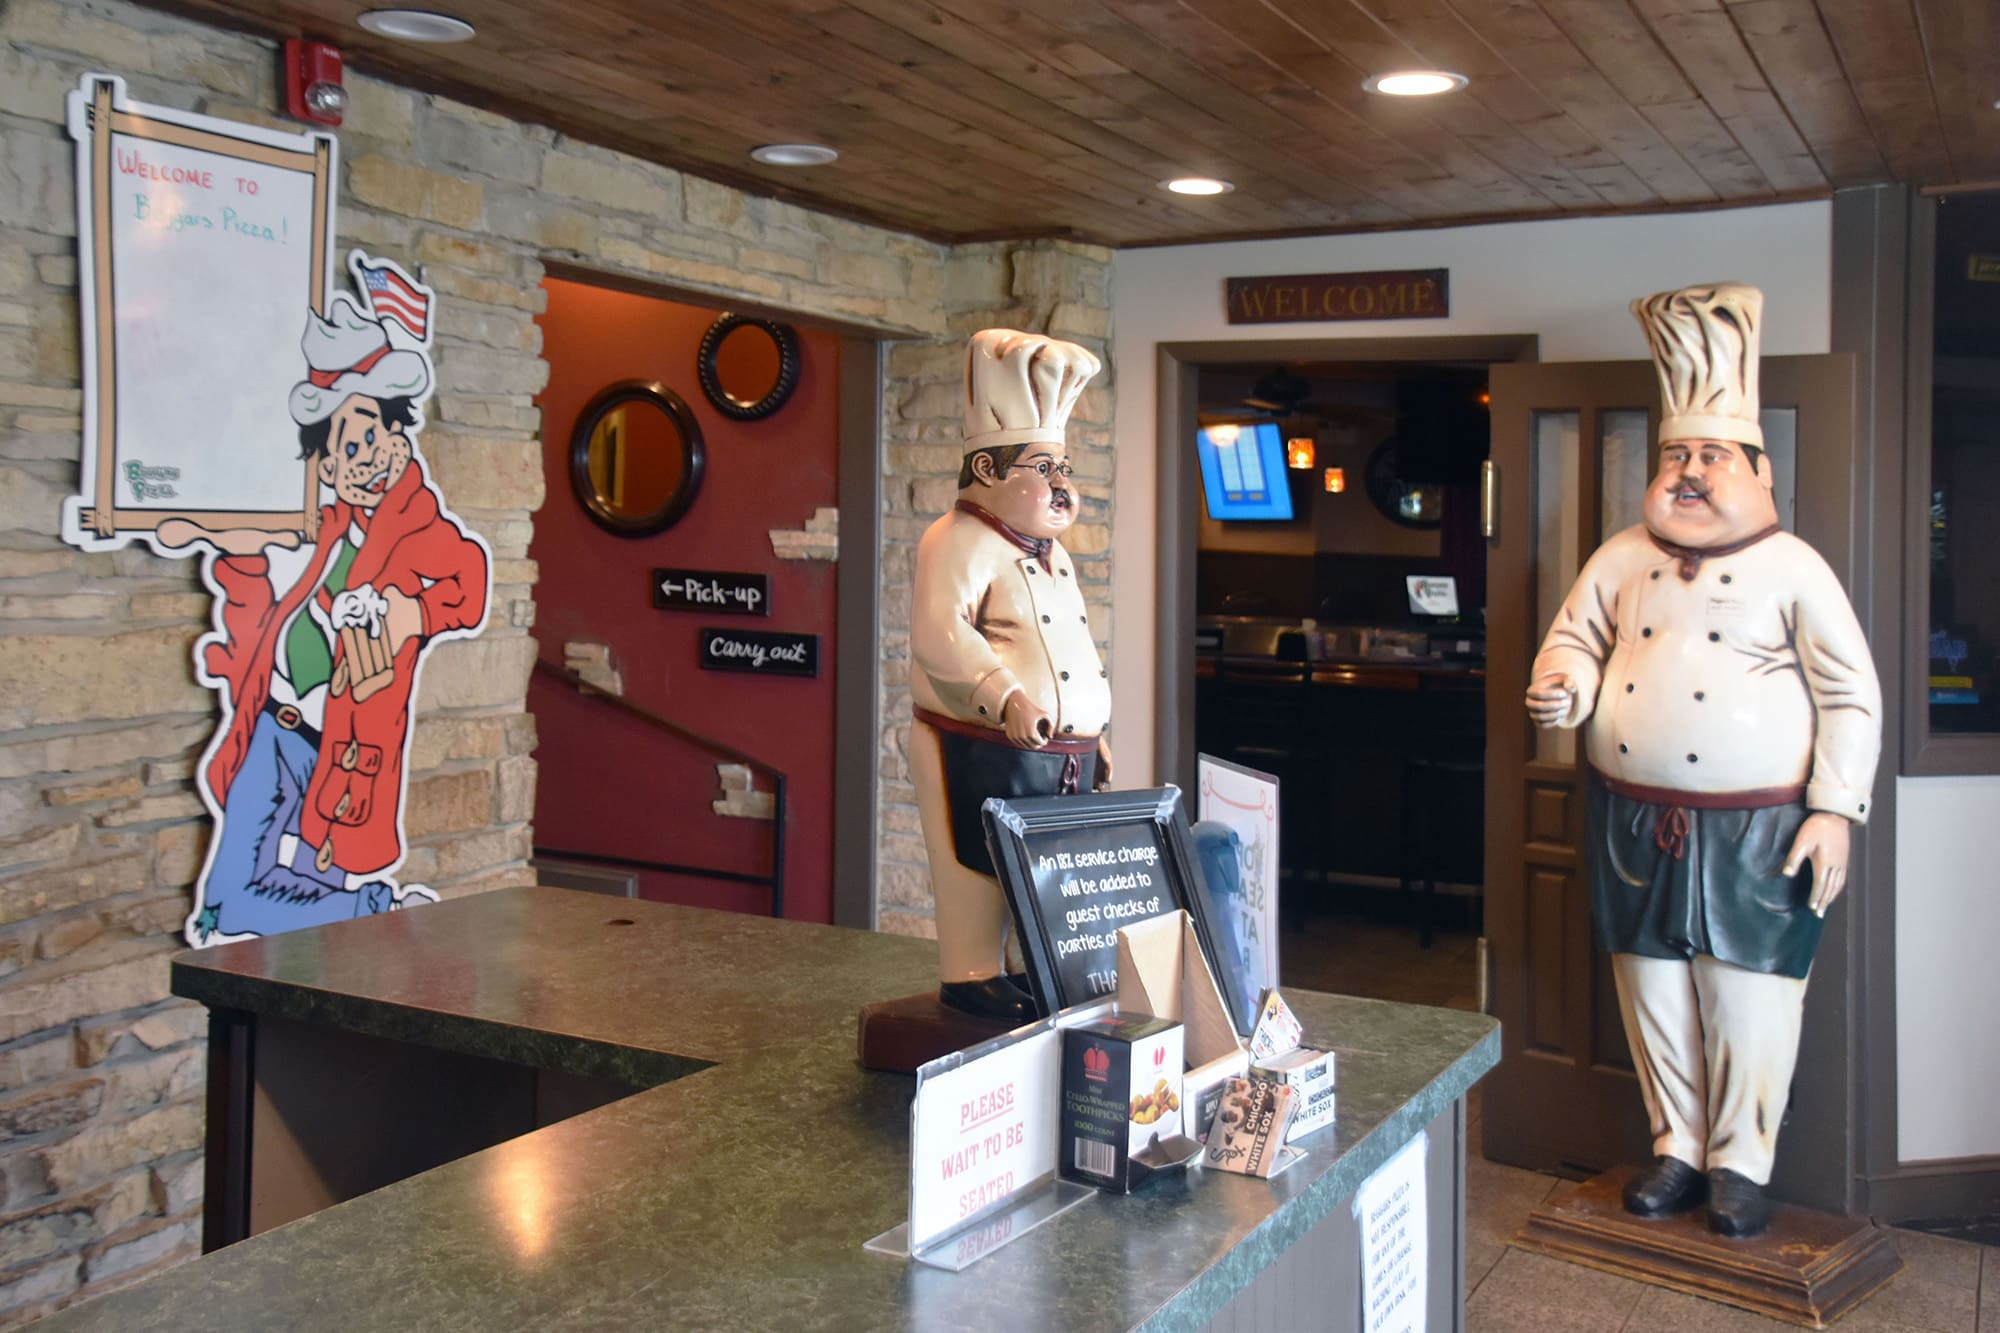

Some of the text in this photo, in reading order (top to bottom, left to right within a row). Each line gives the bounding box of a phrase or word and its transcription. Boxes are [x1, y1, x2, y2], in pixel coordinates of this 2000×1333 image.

[117, 147, 260, 195] WELCOME TO
[1239, 280, 1436, 318] WELCOME
[685, 578, 762, 610] Pick-up
[709, 637, 807, 667] Carry out
[1039, 846, 1158, 872] An 18% service charge
[1060, 871, 1152, 897] will be added to
[1066, 896, 1160, 931] guest checks of
[1057, 930, 1118, 959] parties of
[960, 1082, 1014, 1127] PLEASE
[1067, 1100, 1126, 1122] TOOTHPICKS
[1246, 1081, 1268, 1131] CHICAGO
[1318, 1099, 1331, 1114] SOX
[941, 1121, 1024, 1180] WAIT TO BE
[1247, 1111, 1274, 1172] WHITE SOX
[959, 1170, 1015, 1218] SEATED
